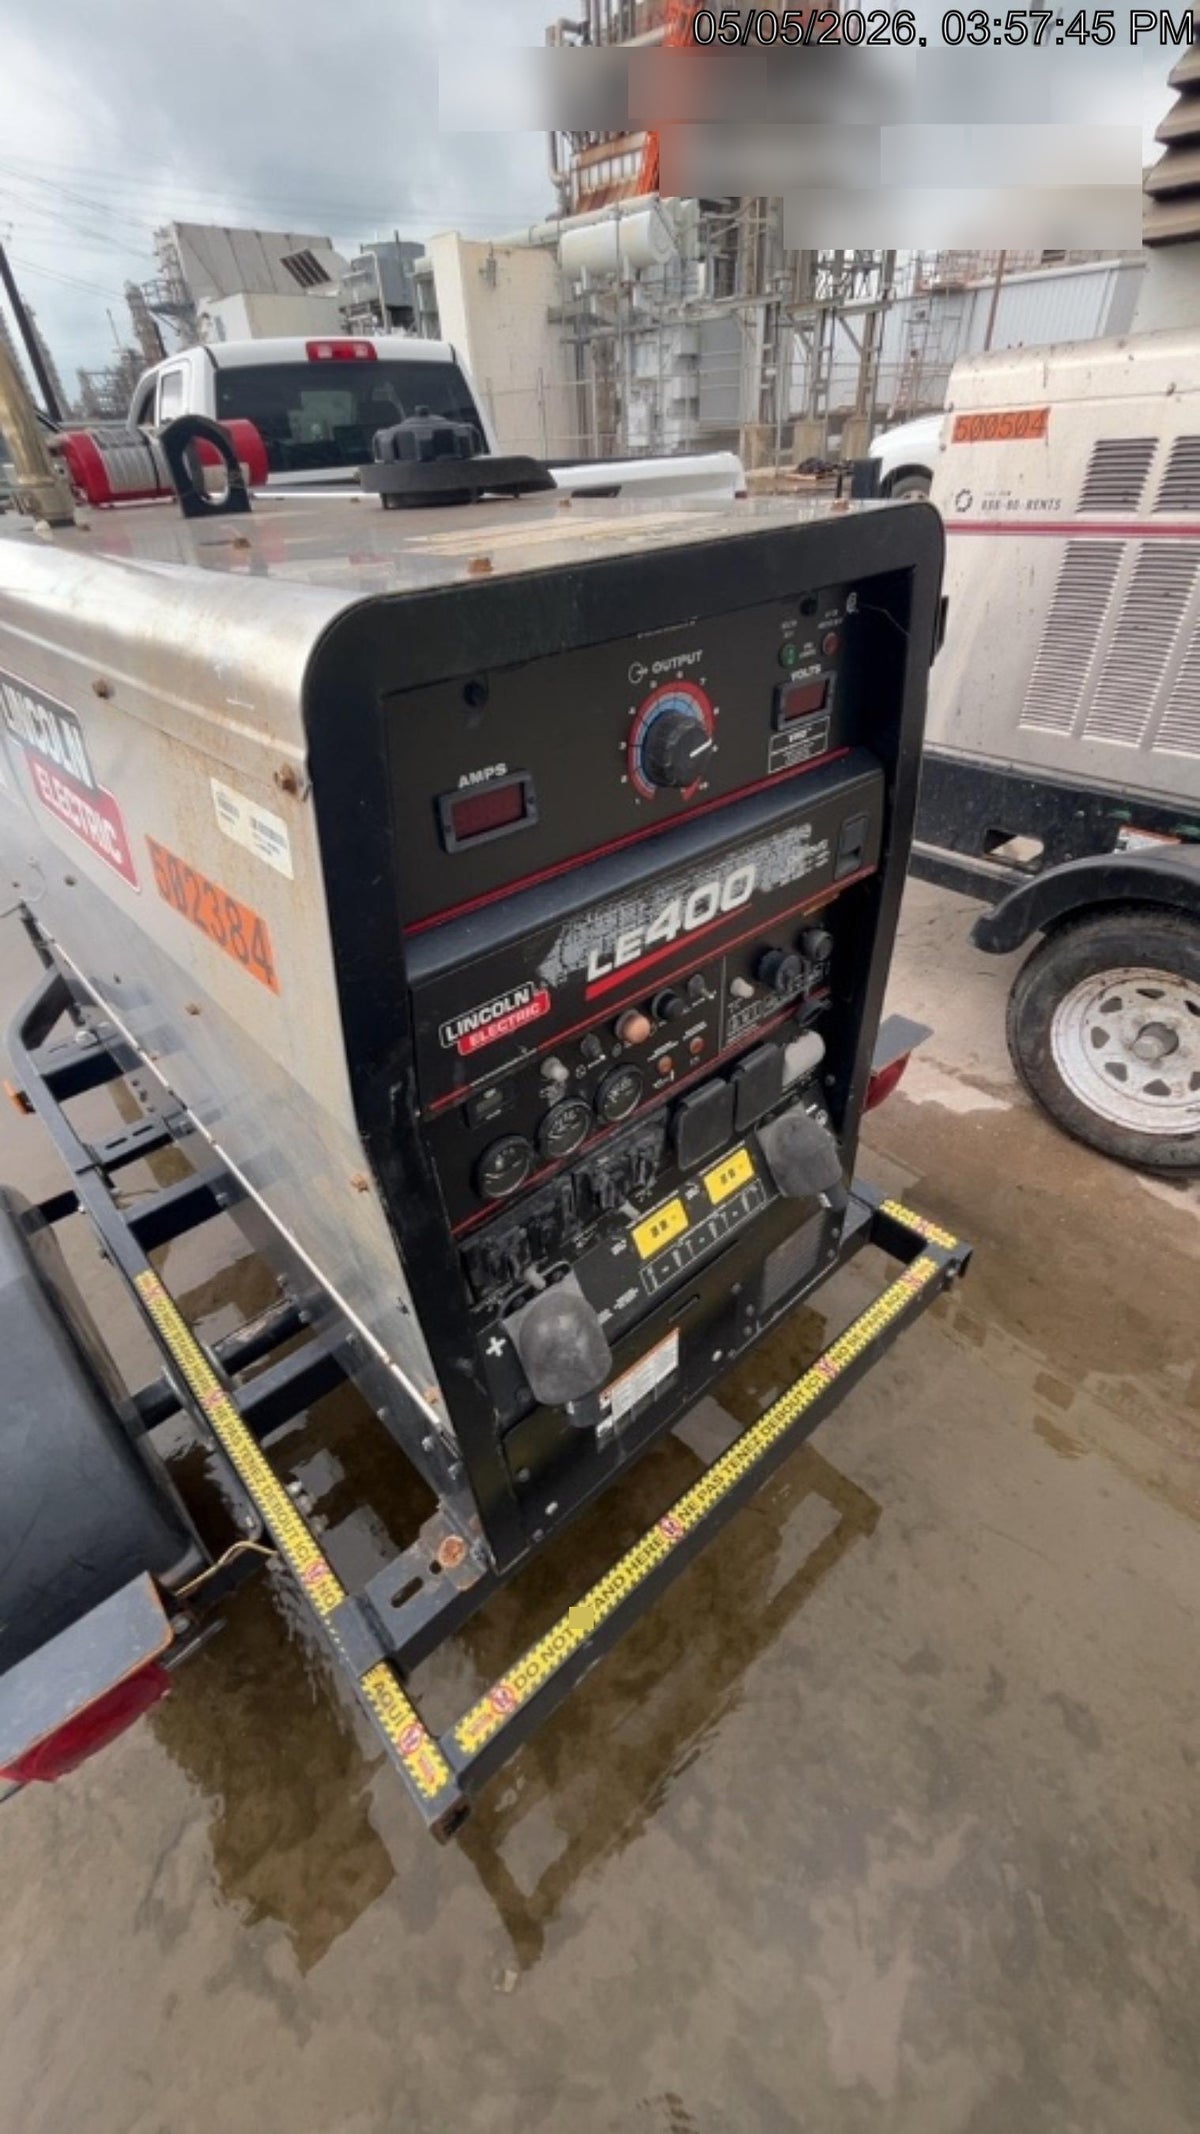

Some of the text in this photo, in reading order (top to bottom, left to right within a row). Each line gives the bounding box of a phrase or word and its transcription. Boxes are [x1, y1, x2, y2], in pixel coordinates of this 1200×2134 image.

[953, 408, 1049, 443] 500504
[651, 649, 703, 674] OUTPUT
[34, 761, 123, 865] ELECTRIC
[458, 763, 508, 788] AMPS
[147, 839, 273, 985] 502384
[588, 864, 756, 982] LE400
[445, 988, 531, 1042] LINCOLN
[470, 1002, 540, 1048] ELECTRIC
[677, 1500, 699, 1521] NE
[697, 1474, 724, 1503] PAS
[722, 1433, 761, 1474] TENEZ
[760, 1390, 805, 1437] DEBOUT
[514, 1661, 540, 1690] DO
[541, 1627, 575, 1663] NOT
[626, 1534, 664, 1576] HERE
